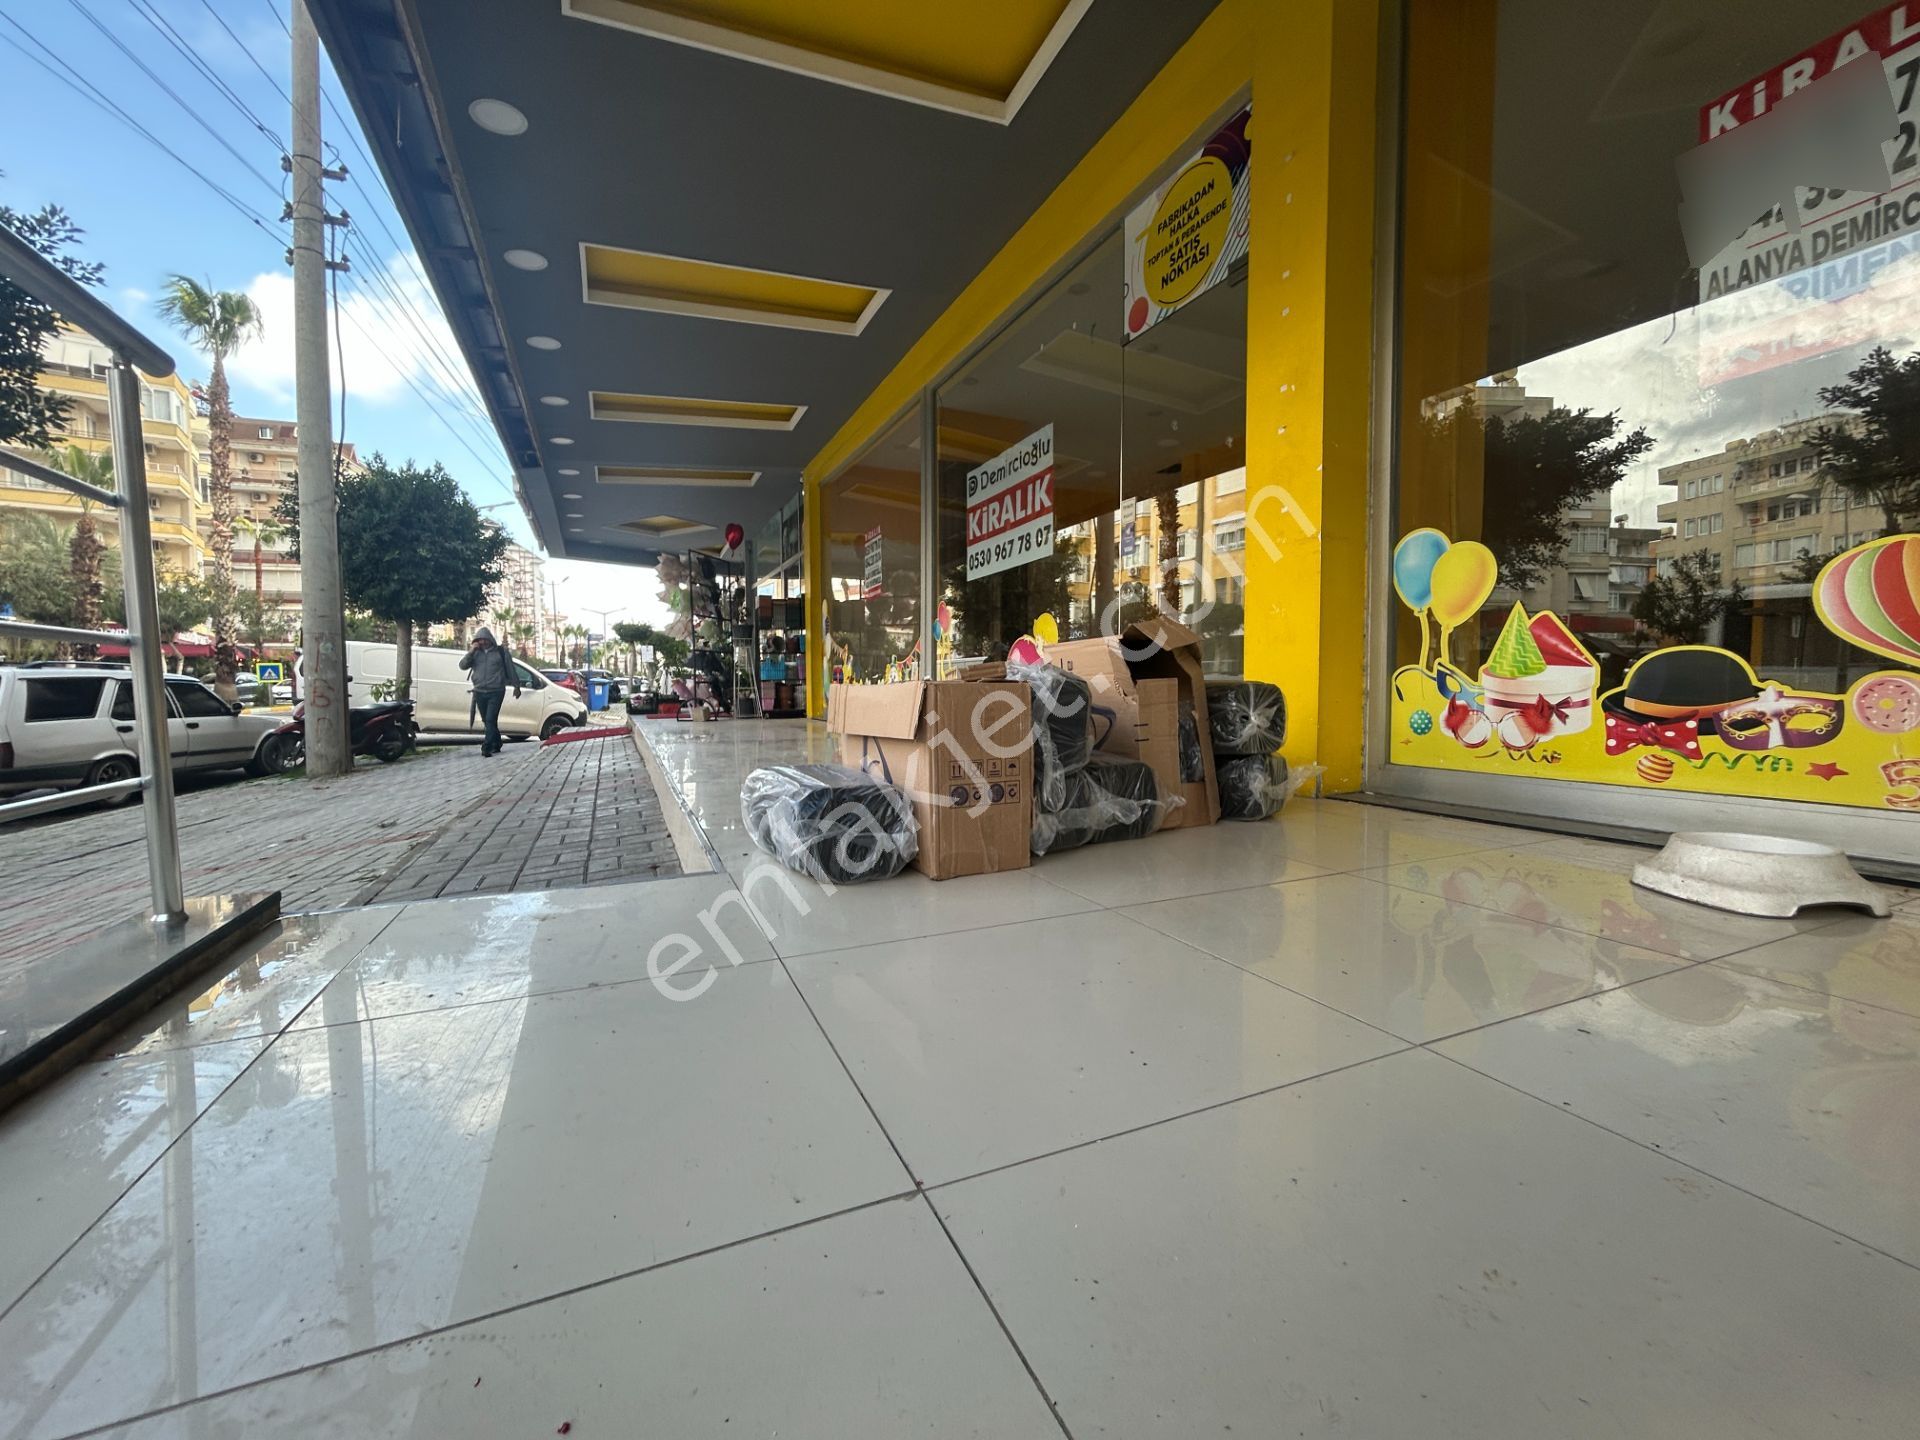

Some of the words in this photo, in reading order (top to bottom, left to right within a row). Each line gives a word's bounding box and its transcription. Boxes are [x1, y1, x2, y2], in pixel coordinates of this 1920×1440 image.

[1147, 242, 1174, 268] TOPTAN
[1181, 199, 1228, 242] PERAKENDE
[1169, 206, 1200, 238] HALKA
[1161, 243, 1210, 290] NOKTASI
[1169, 234, 1201, 268] SATIŞ
[1707, 238, 1805, 300] ALANYA
[980, 438, 1052, 490] Demircioğlu
[969, 550, 992, 571] 0530
[994, 538, 1015, 562] 967
[1017, 532, 1032, 555] 78
[1035, 524, 1052, 548] 07
